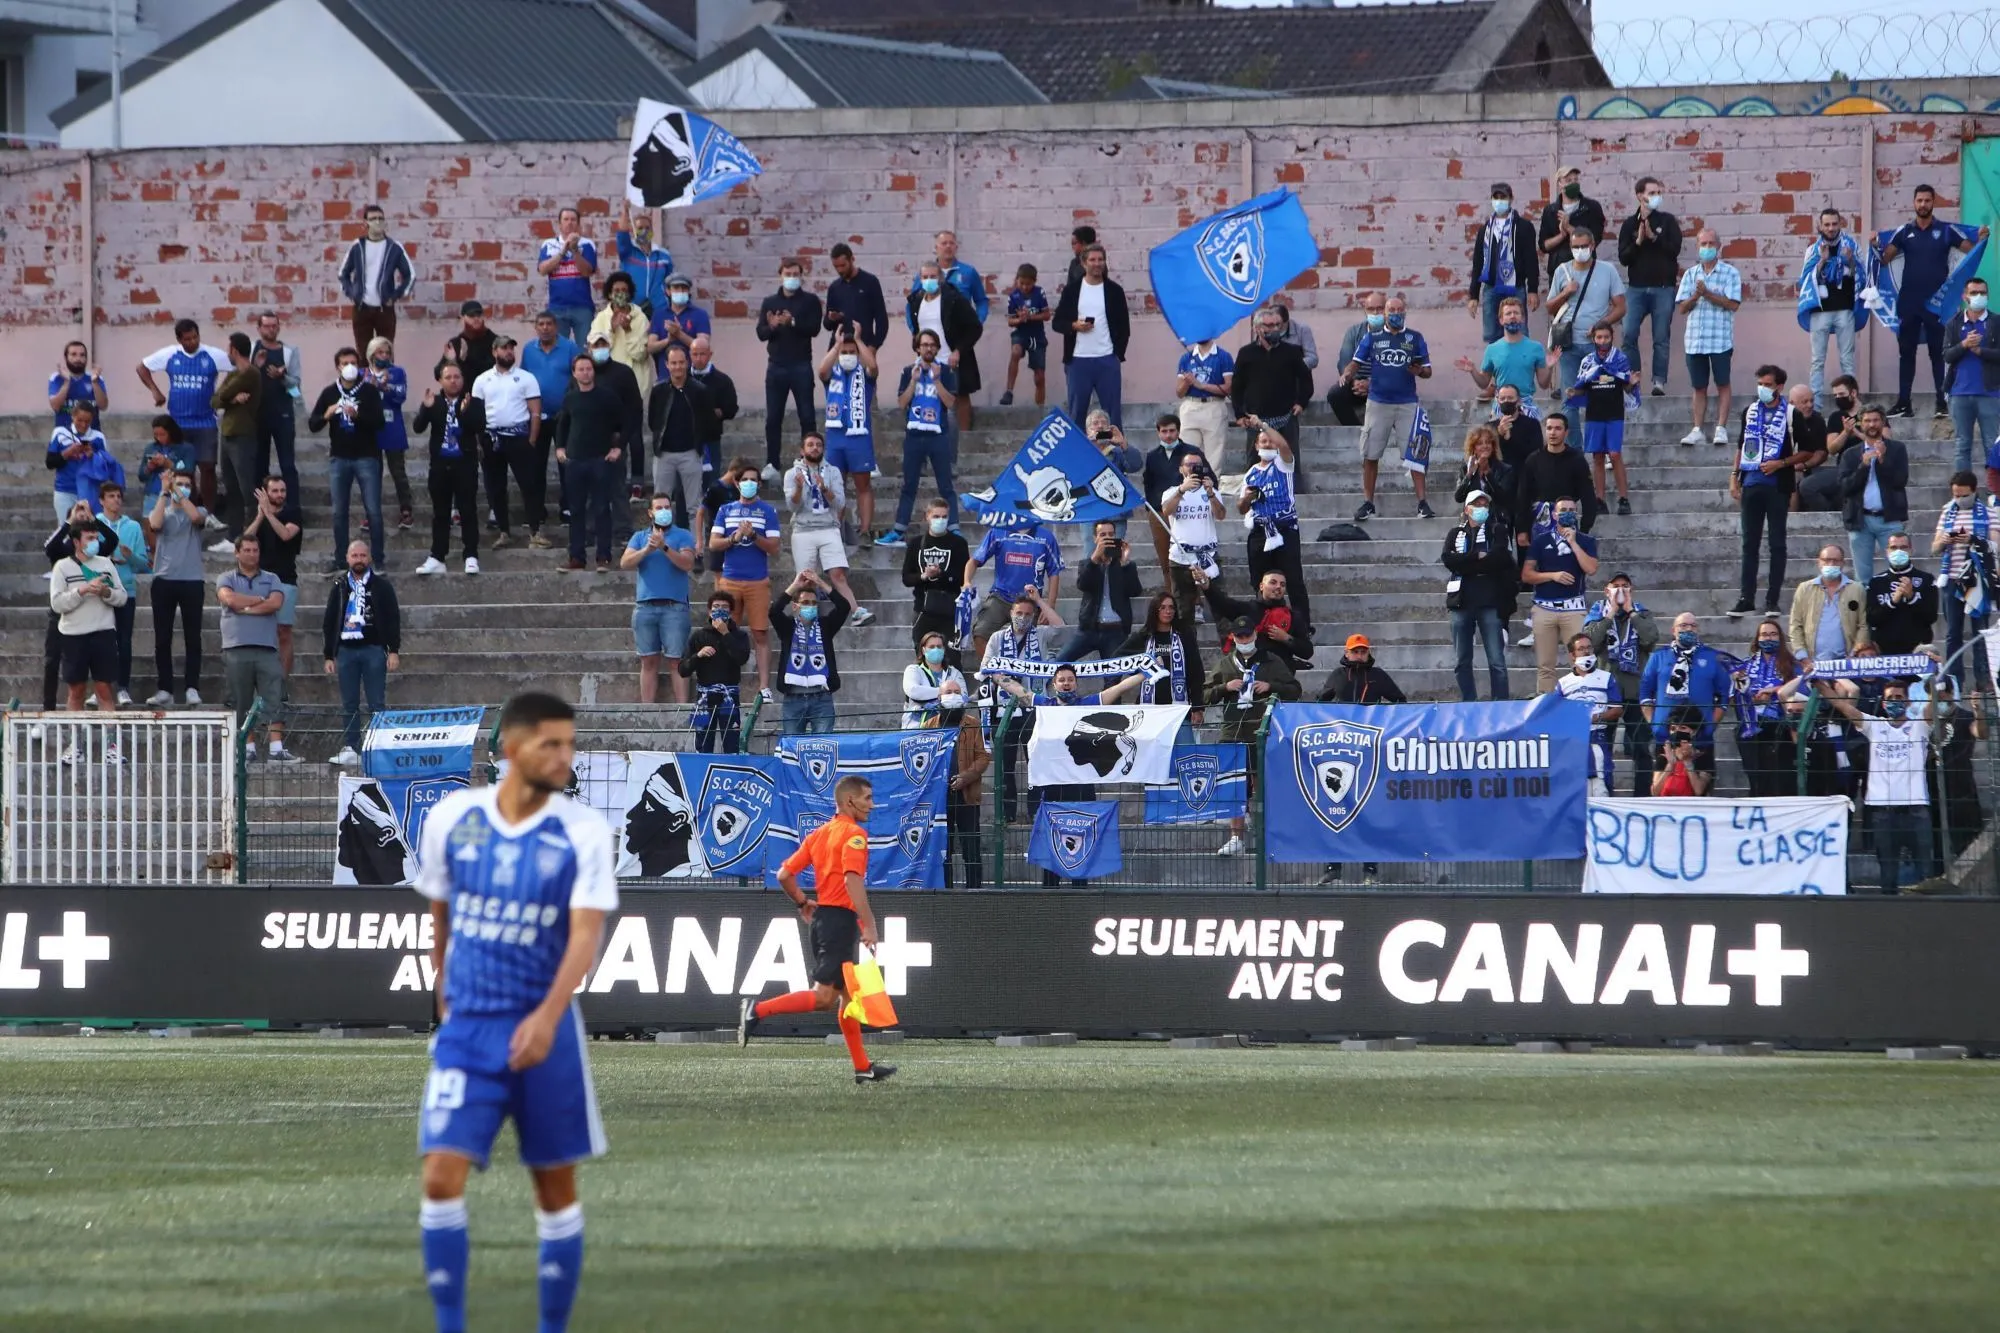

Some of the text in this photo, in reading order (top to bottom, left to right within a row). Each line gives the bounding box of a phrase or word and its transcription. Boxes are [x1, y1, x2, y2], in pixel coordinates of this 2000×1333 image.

[1375, 353, 1412, 364] OSCARO
[986, 656, 1058, 676] BASTIA
[1851, 655, 1930, 670] VINCEREMU
[392, 732, 451, 742] SEMPRE
[1302, 731, 1371, 748] S.C. BASTIA
[419, 755, 443, 768] NOI
[1386, 733, 1550, 775] Ghjuvanni
[1191, 761, 1215, 771] BASTIA
[414, 788, 438, 803] S.C.
[1386, 772, 1550, 802] sempre cù noi
[1328, 807, 1346, 816] 1905
[1732, 805, 1768, 832] LA
[1066, 817, 1092, 827] BASTIA
[1588, 806, 1708, 882] BOCO
[1092, 917, 1344, 958] SEULEMENT
[1379, 919, 1810, 1007] CANAL+
[1229, 961, 1345, 1002] AVEC
[426, 1067, 467, 1112] 19
